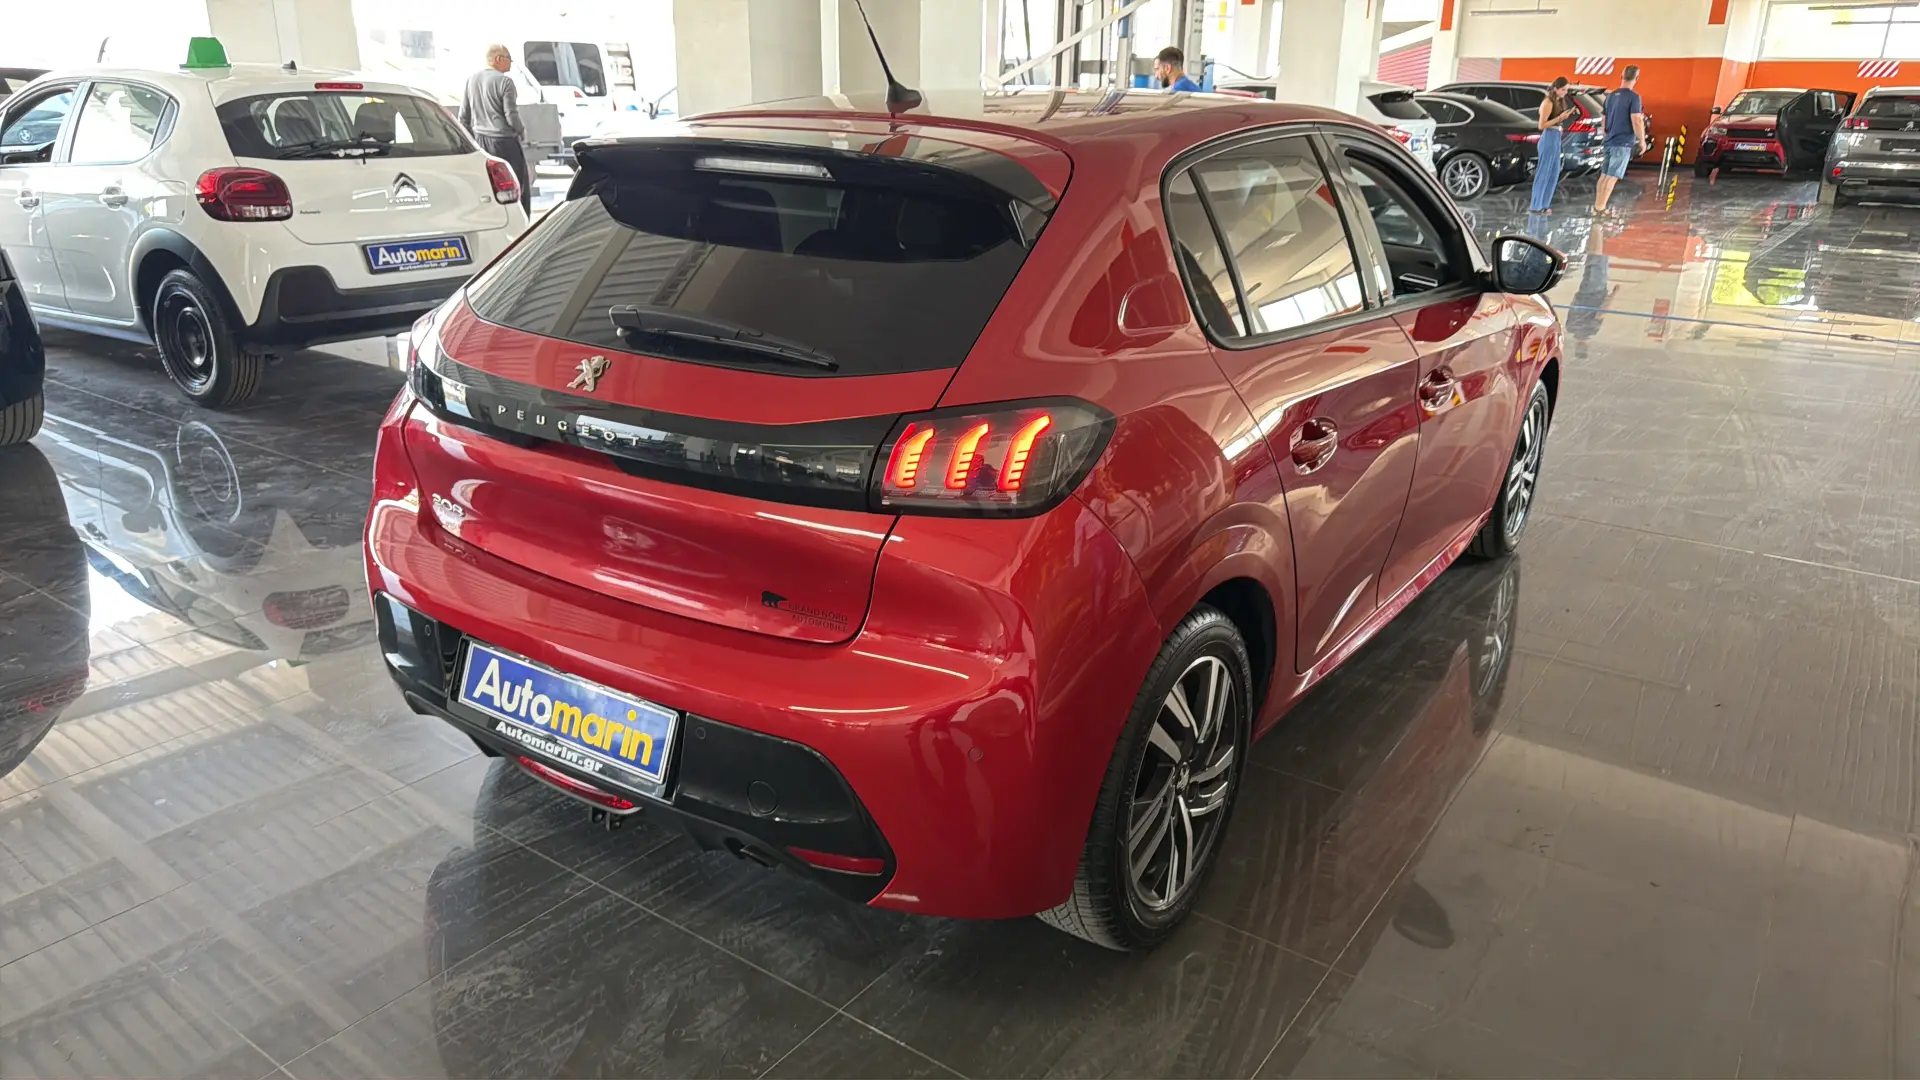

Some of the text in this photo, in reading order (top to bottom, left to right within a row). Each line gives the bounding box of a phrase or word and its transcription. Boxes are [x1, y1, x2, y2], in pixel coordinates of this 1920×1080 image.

[377, 241, 461, 266] Automarin
[497, 404, 640, 447] PEUGEOT
[432, 492, 465, 517] 208
[472, 657, 653, 767] Automarin
[495, 720, 603, 772] Automarin.gr
